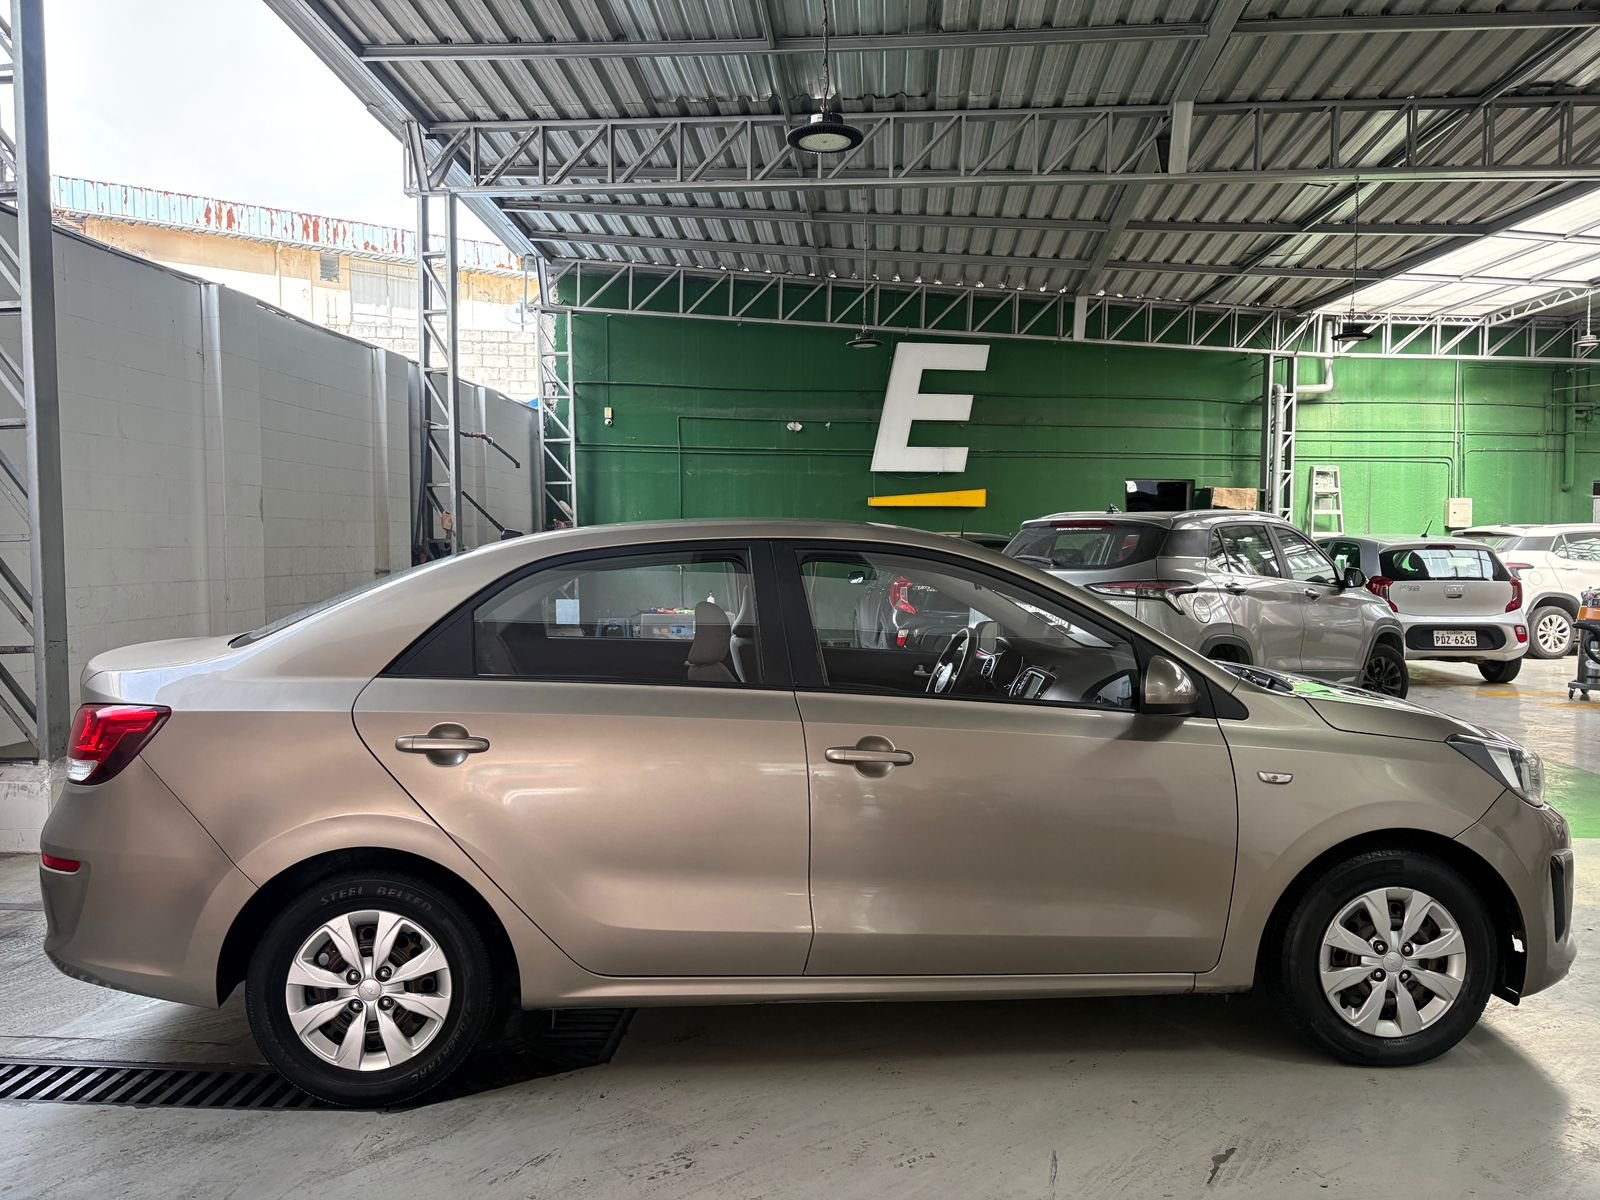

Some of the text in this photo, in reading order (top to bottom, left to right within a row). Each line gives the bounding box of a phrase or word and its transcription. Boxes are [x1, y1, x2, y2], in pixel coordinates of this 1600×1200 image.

[870, 342, 990, 472] E
[1435, 635, 1476, 645] PDZ-6245
[320, 886, 433, 911] STEEL BELTED
